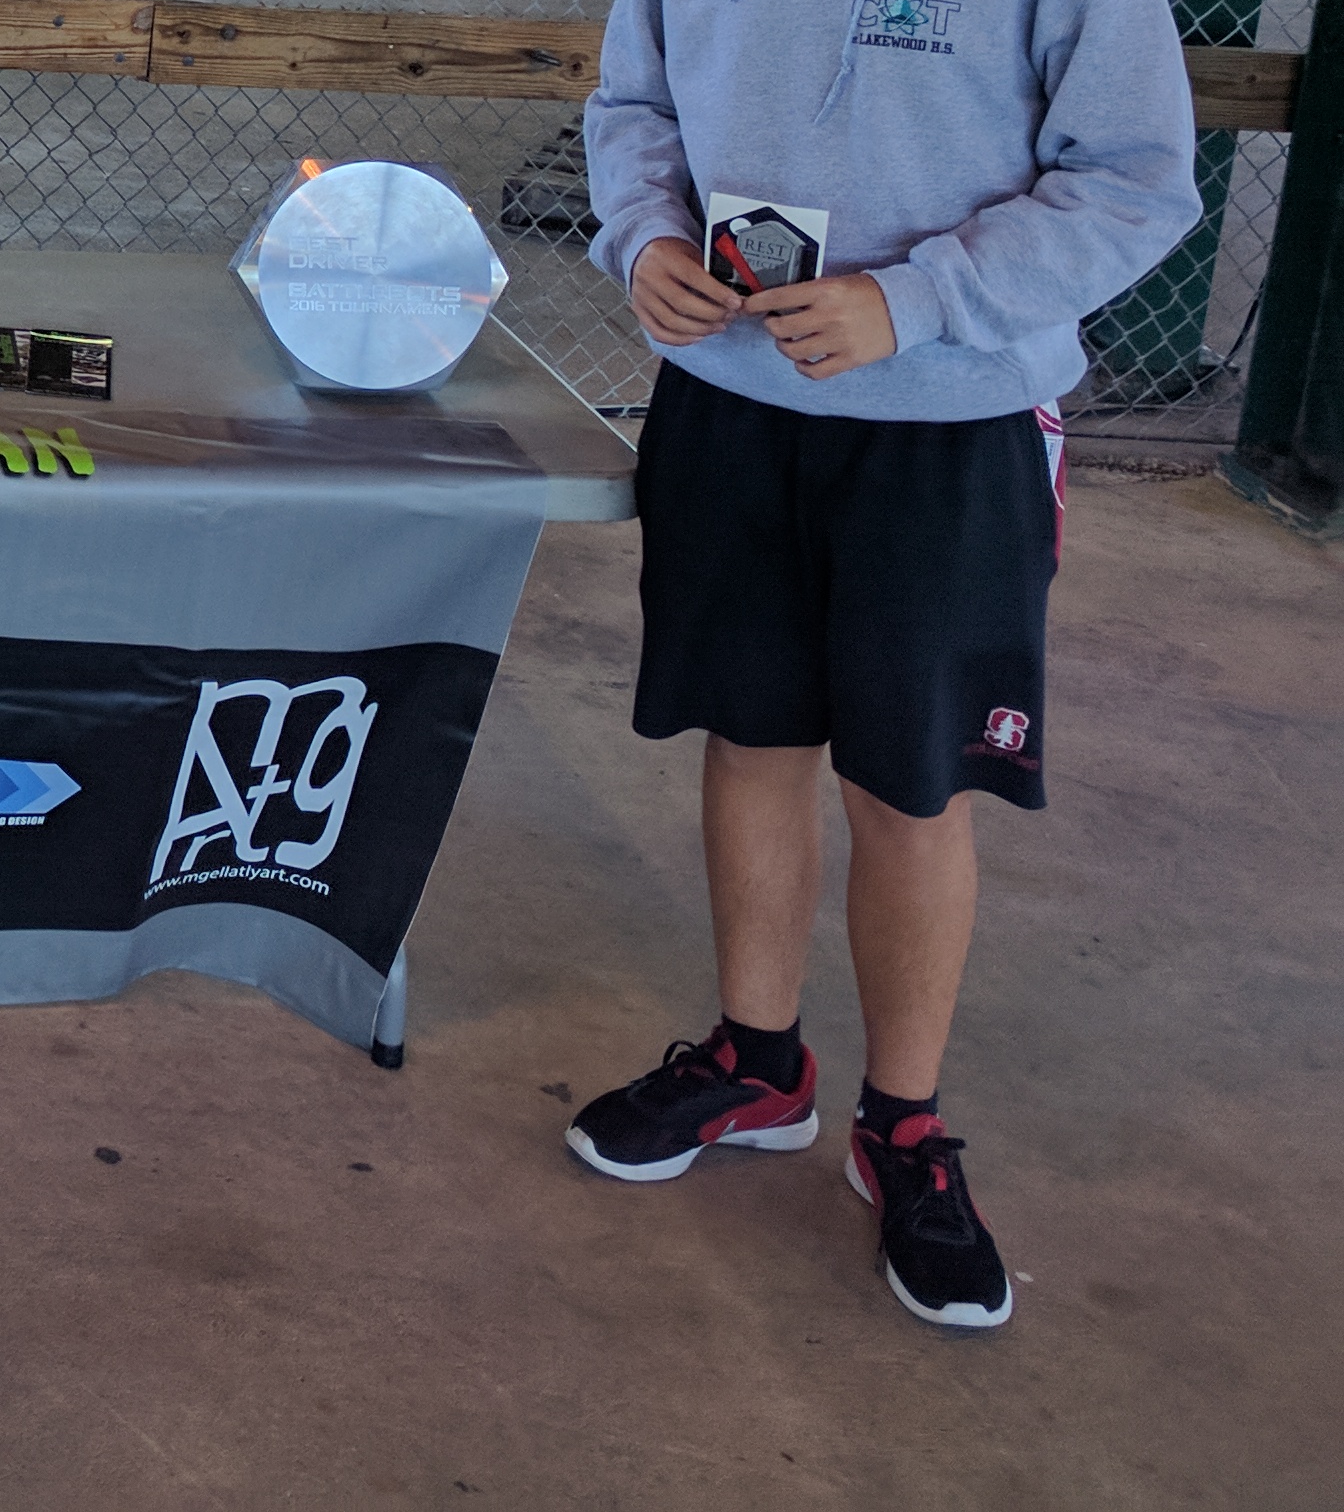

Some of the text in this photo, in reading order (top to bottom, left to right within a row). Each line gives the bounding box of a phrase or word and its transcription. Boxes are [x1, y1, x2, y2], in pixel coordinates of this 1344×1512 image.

[931, 41, 955, 55] H.S.
[745, 238, 786, 257] REST
[287, 282, 462, 303] BATTLEBOTS
[289, 299, 461, 316] 2016 TOURNAMENT
[7, 816, 46, 826] DESIGN
[143, 865, 331, 901] www.mgellatlyart.com
